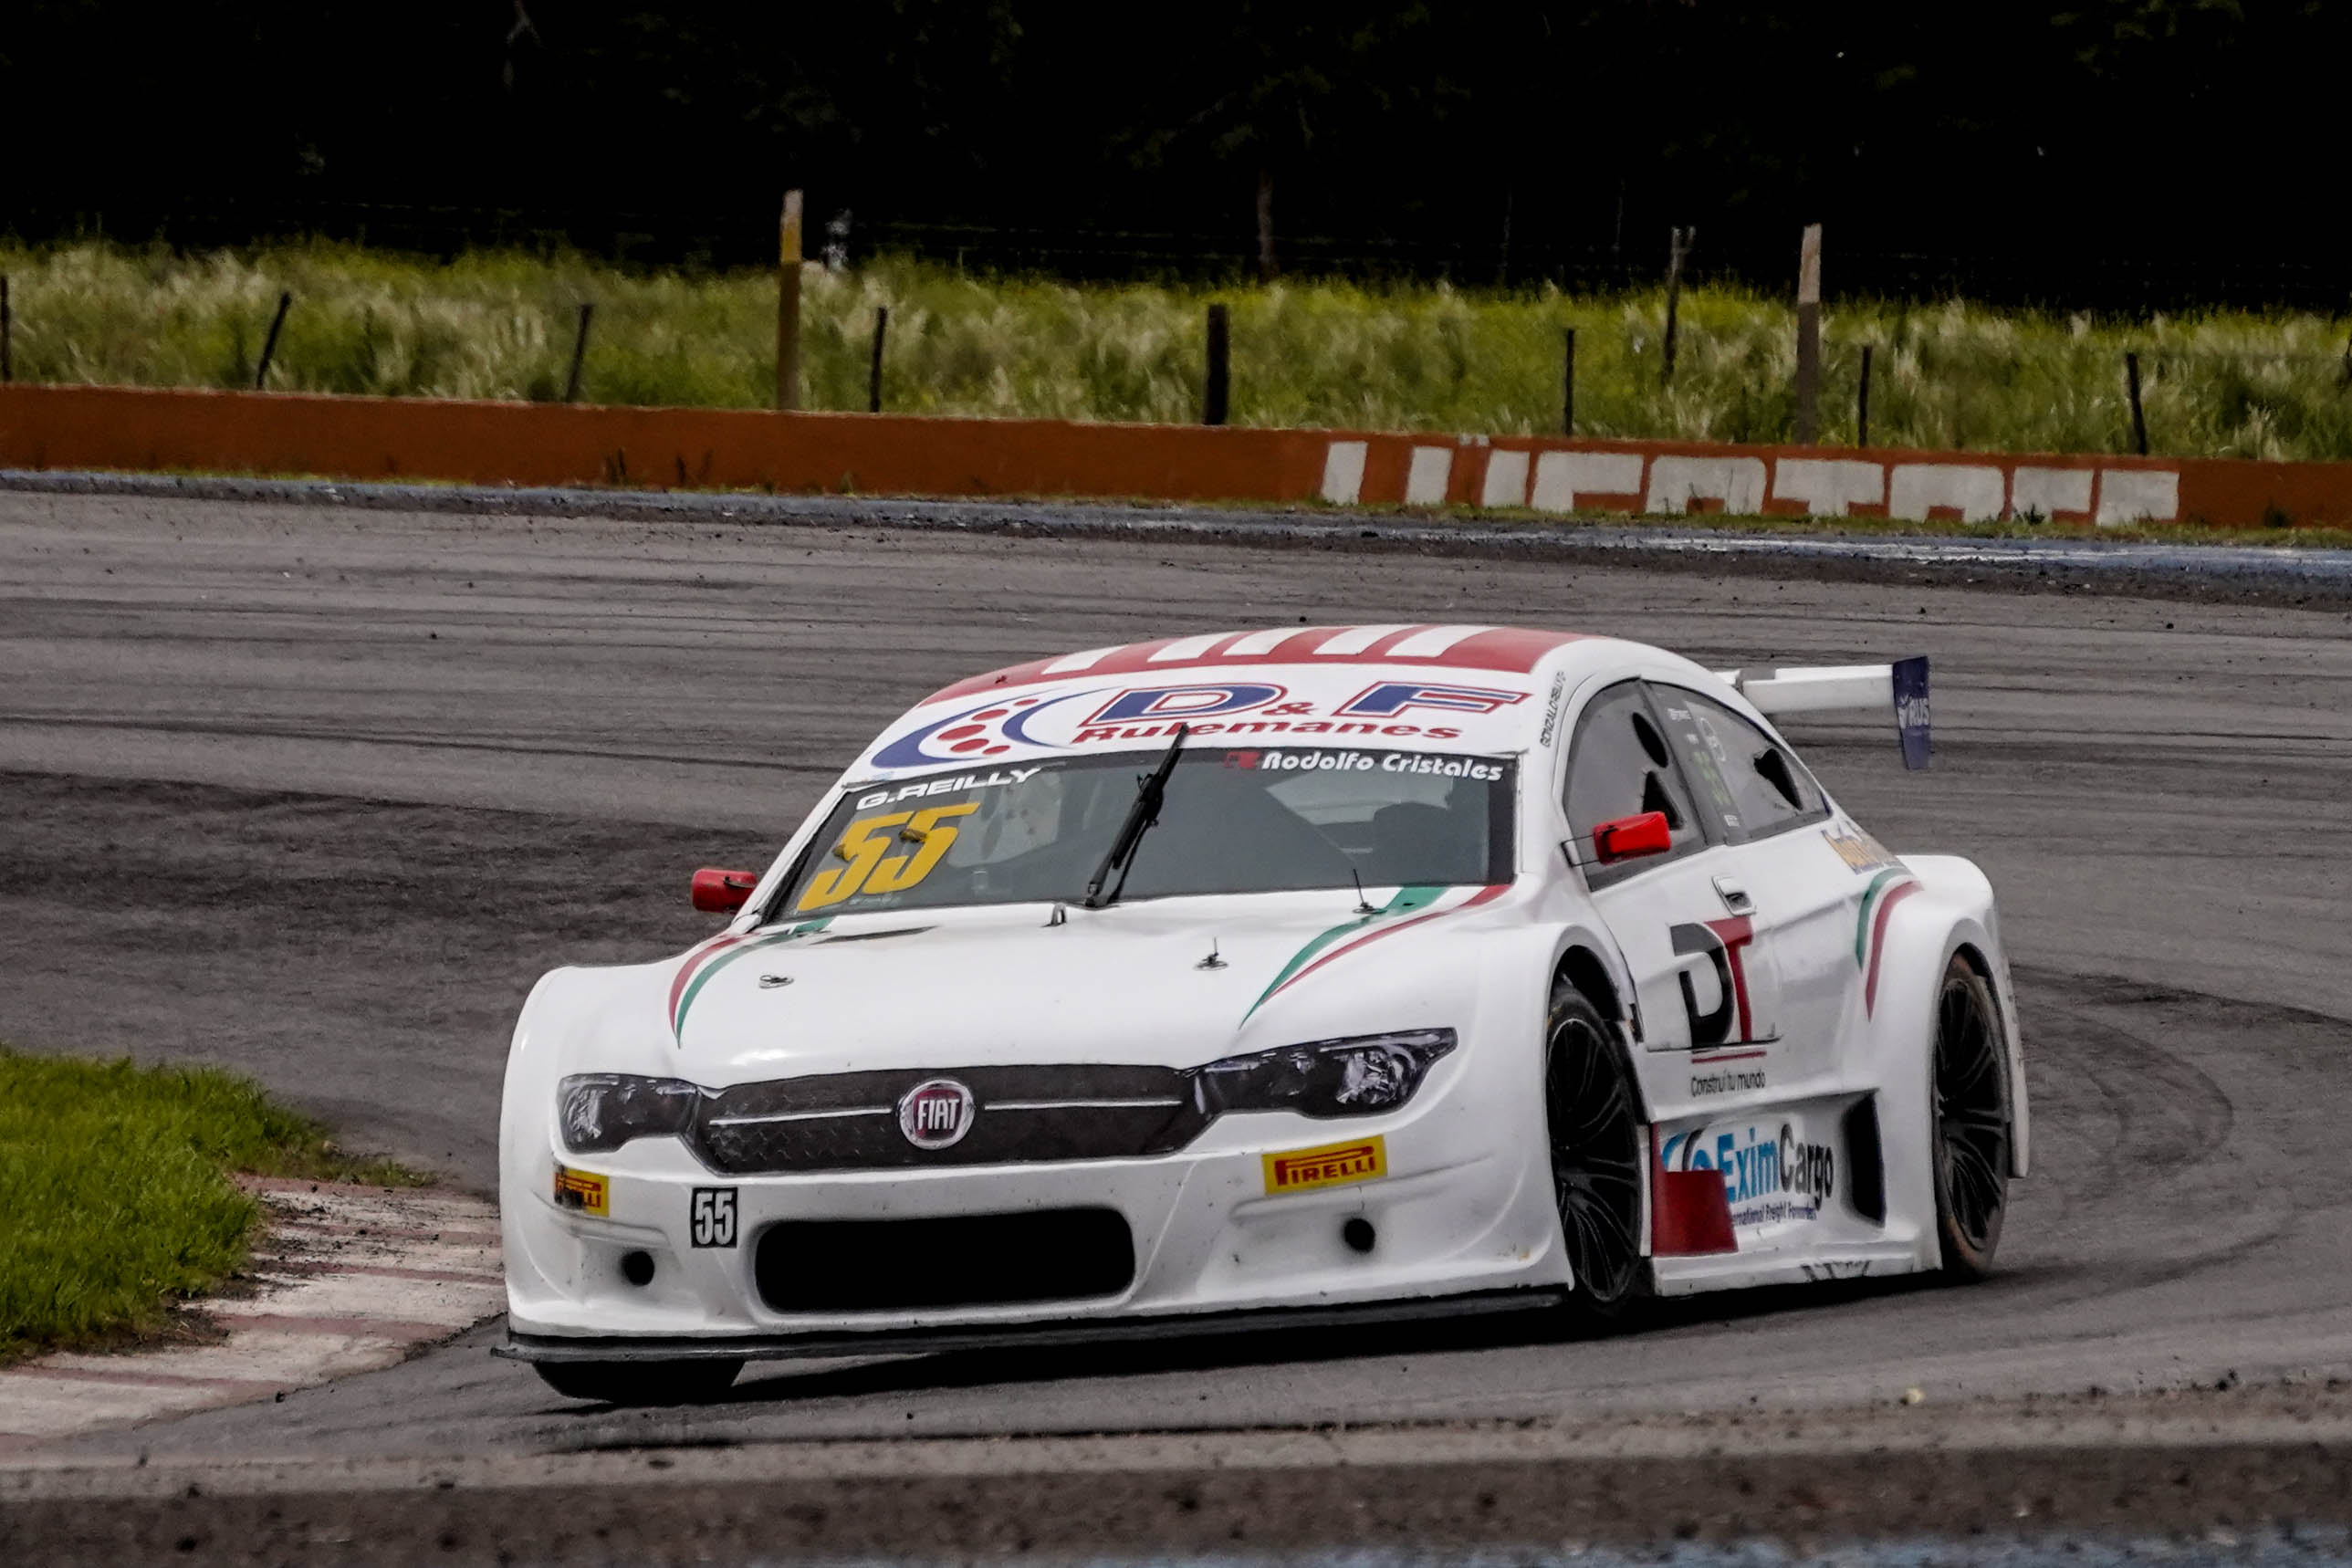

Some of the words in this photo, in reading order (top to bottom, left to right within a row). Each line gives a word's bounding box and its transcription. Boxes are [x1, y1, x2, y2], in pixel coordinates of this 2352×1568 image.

[1078, 683, 1288, 728] D
[1261, 701, 1318, 716] &
[1330, 680, 1534, 719] F
[1070, 722, 1463, 745] Rulemanes
[1261, 751, 1375, 771] Rodolfo
[1381, 753, 1504, 782] Cristales
[855, 767, 1041, 810] G.REILLY
[796, 802, 981, 912] 55
[1737, 1068, 1766, 1092] mundo
[917, 1099, 960, 1130] FIAT
[1274, 1145, 1375, 1186] PIRELLI
[695, 1191, 735, 1246] 55
